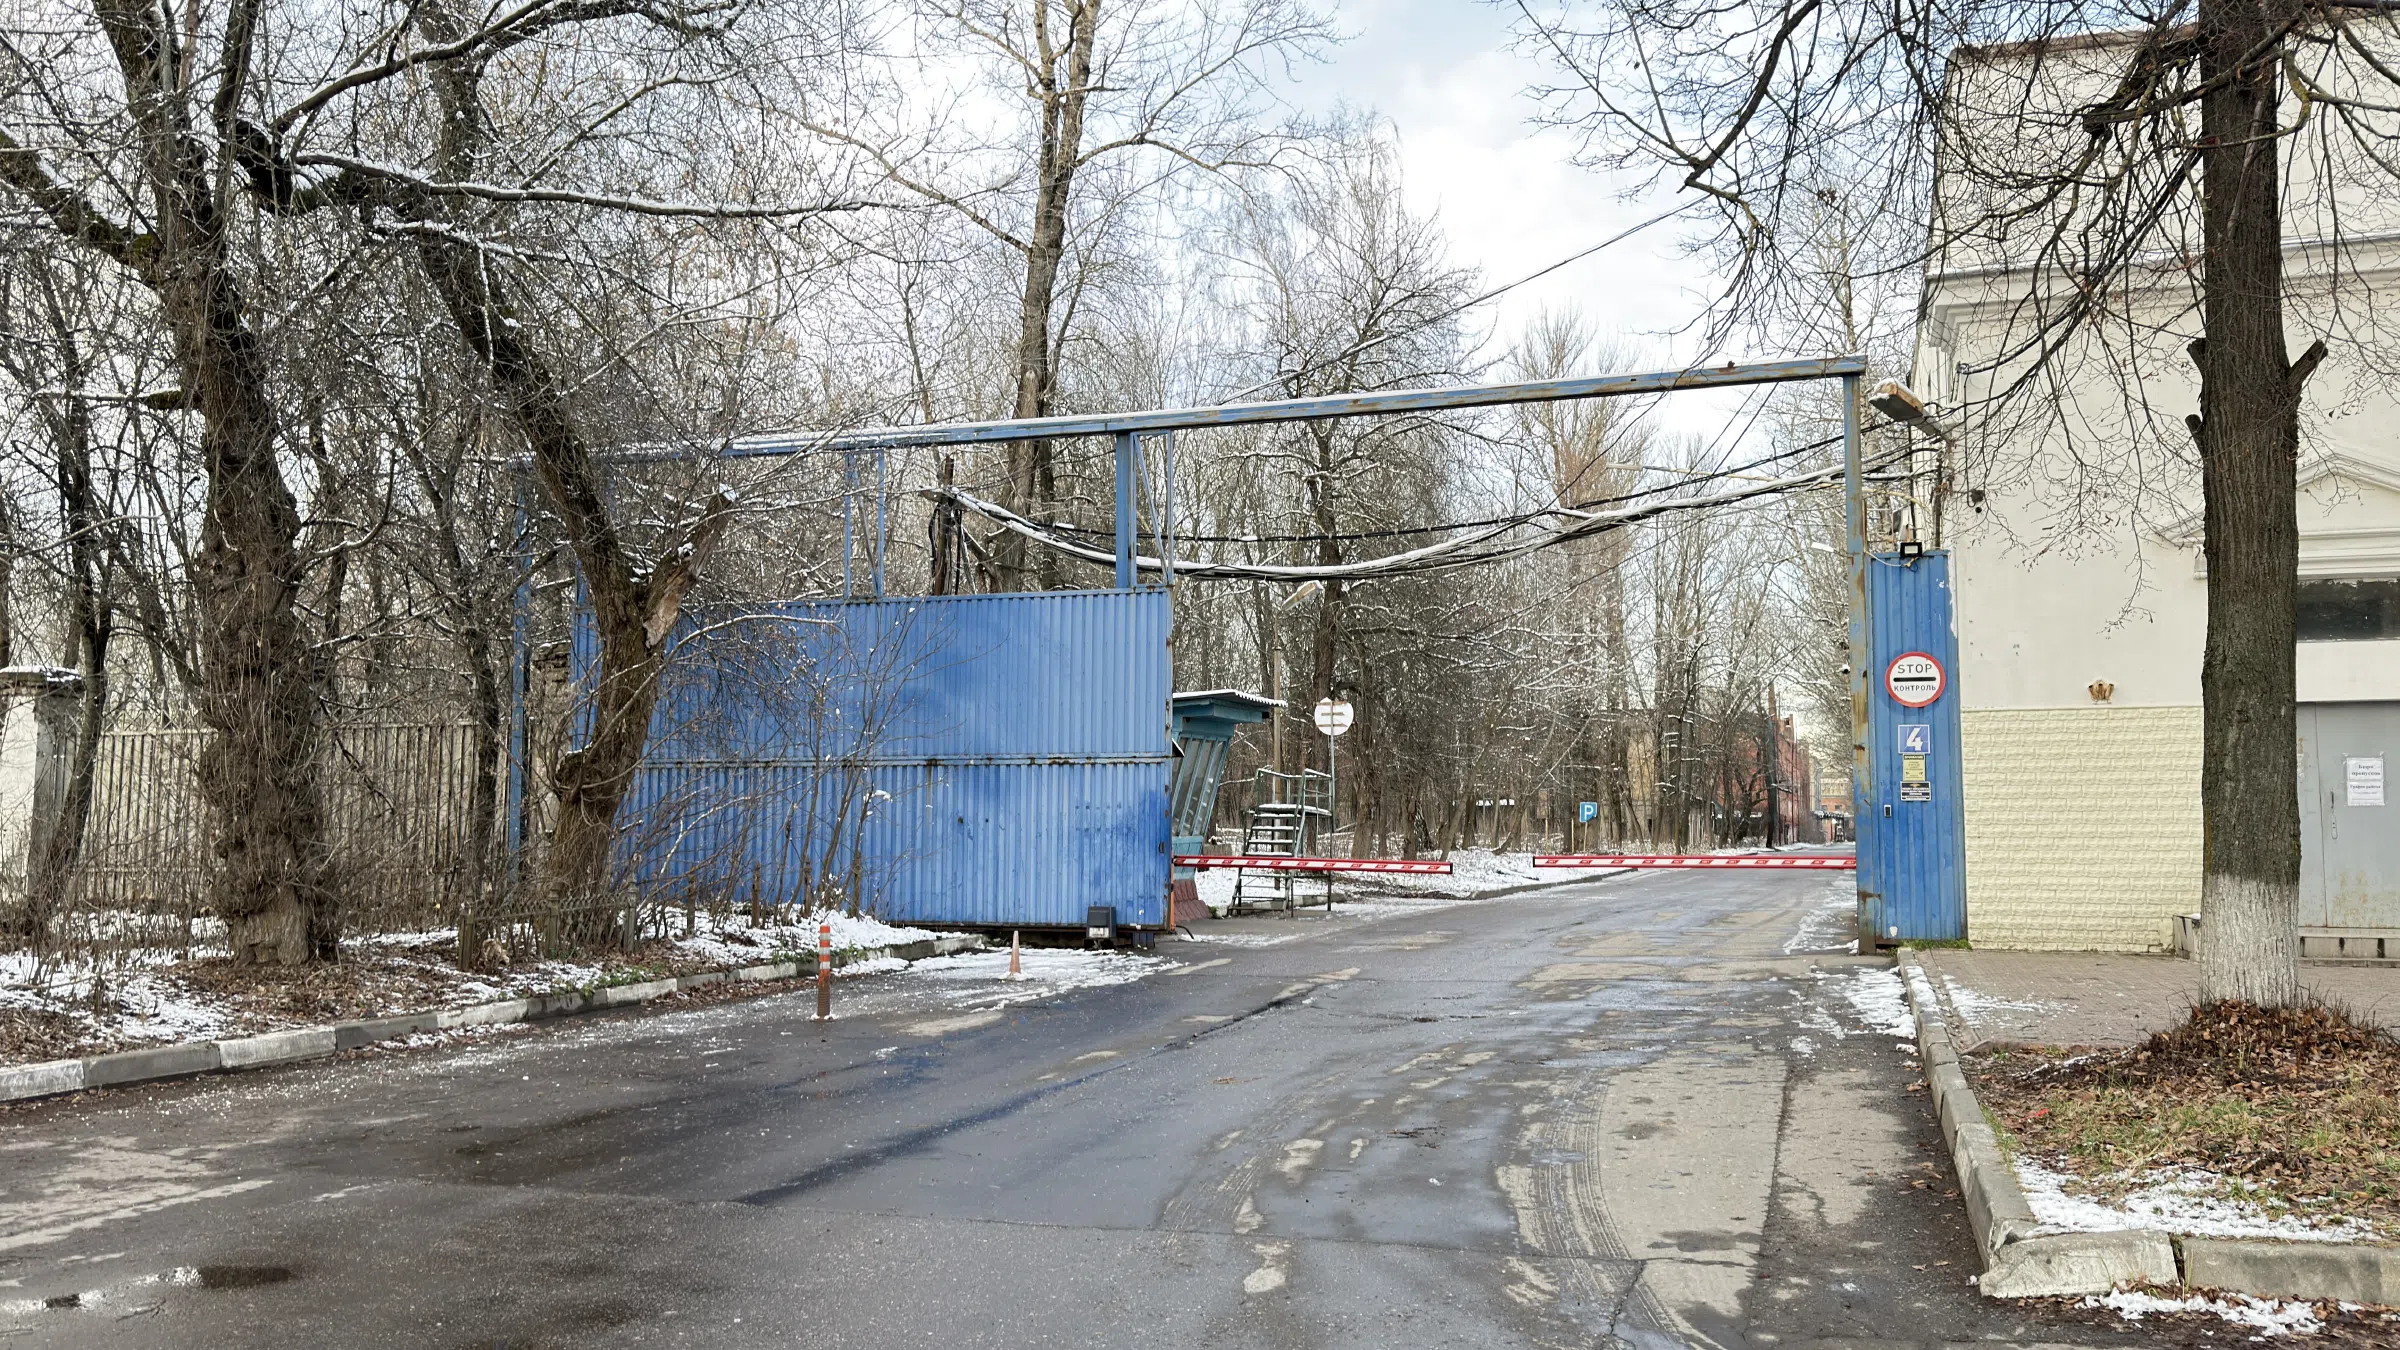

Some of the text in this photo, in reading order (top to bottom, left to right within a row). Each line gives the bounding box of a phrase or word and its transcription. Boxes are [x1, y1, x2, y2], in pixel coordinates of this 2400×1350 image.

[1897, 663, 1932, 674] STOP
[1893, 684, 1937, 692] КОНТРОЛЬ
[1906, 727, 1923, 751] 4
[1584, 804, 1594, 820] P
